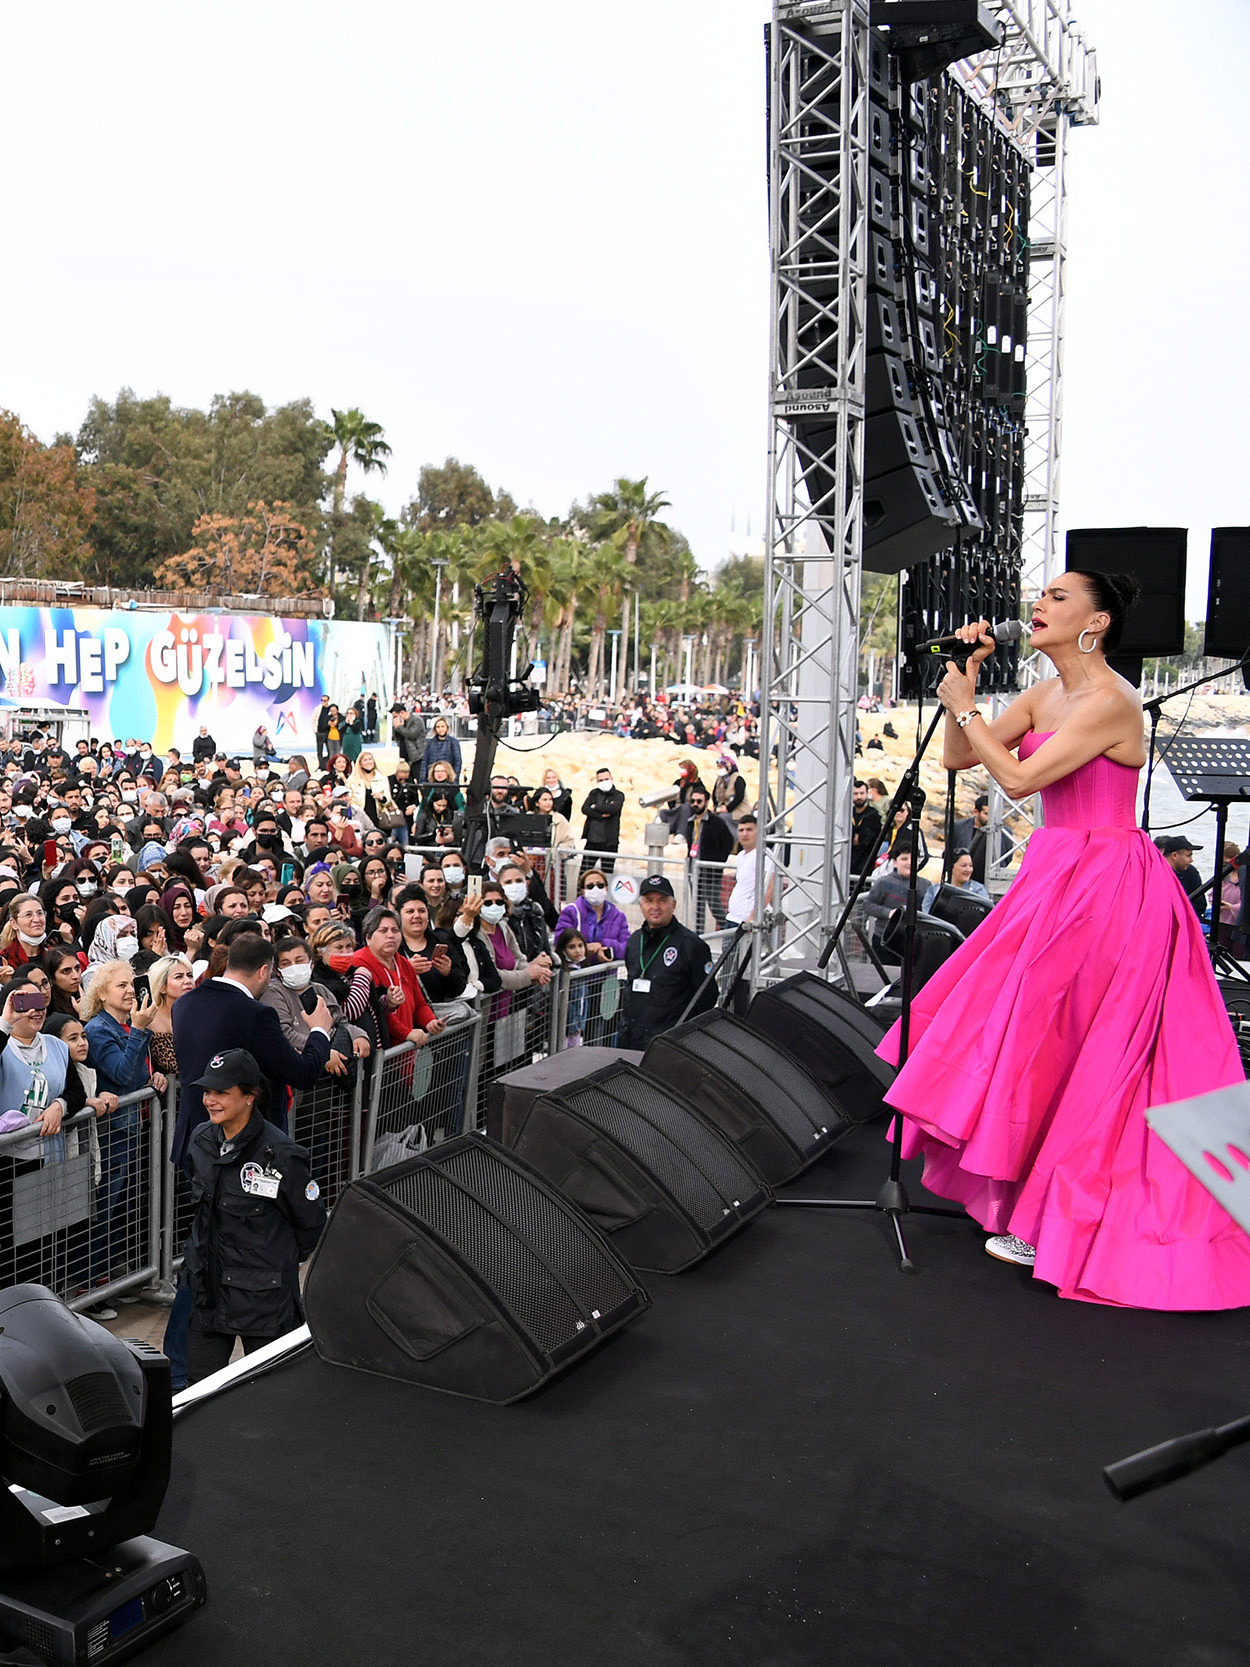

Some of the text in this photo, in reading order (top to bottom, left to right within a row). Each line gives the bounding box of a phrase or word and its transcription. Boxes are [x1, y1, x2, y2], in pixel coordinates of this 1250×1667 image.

[784, 403, 831, 414] Asound
[44, 628, 130, 693] HEP
[149, 627, 315, 696] GÜZELSİN
